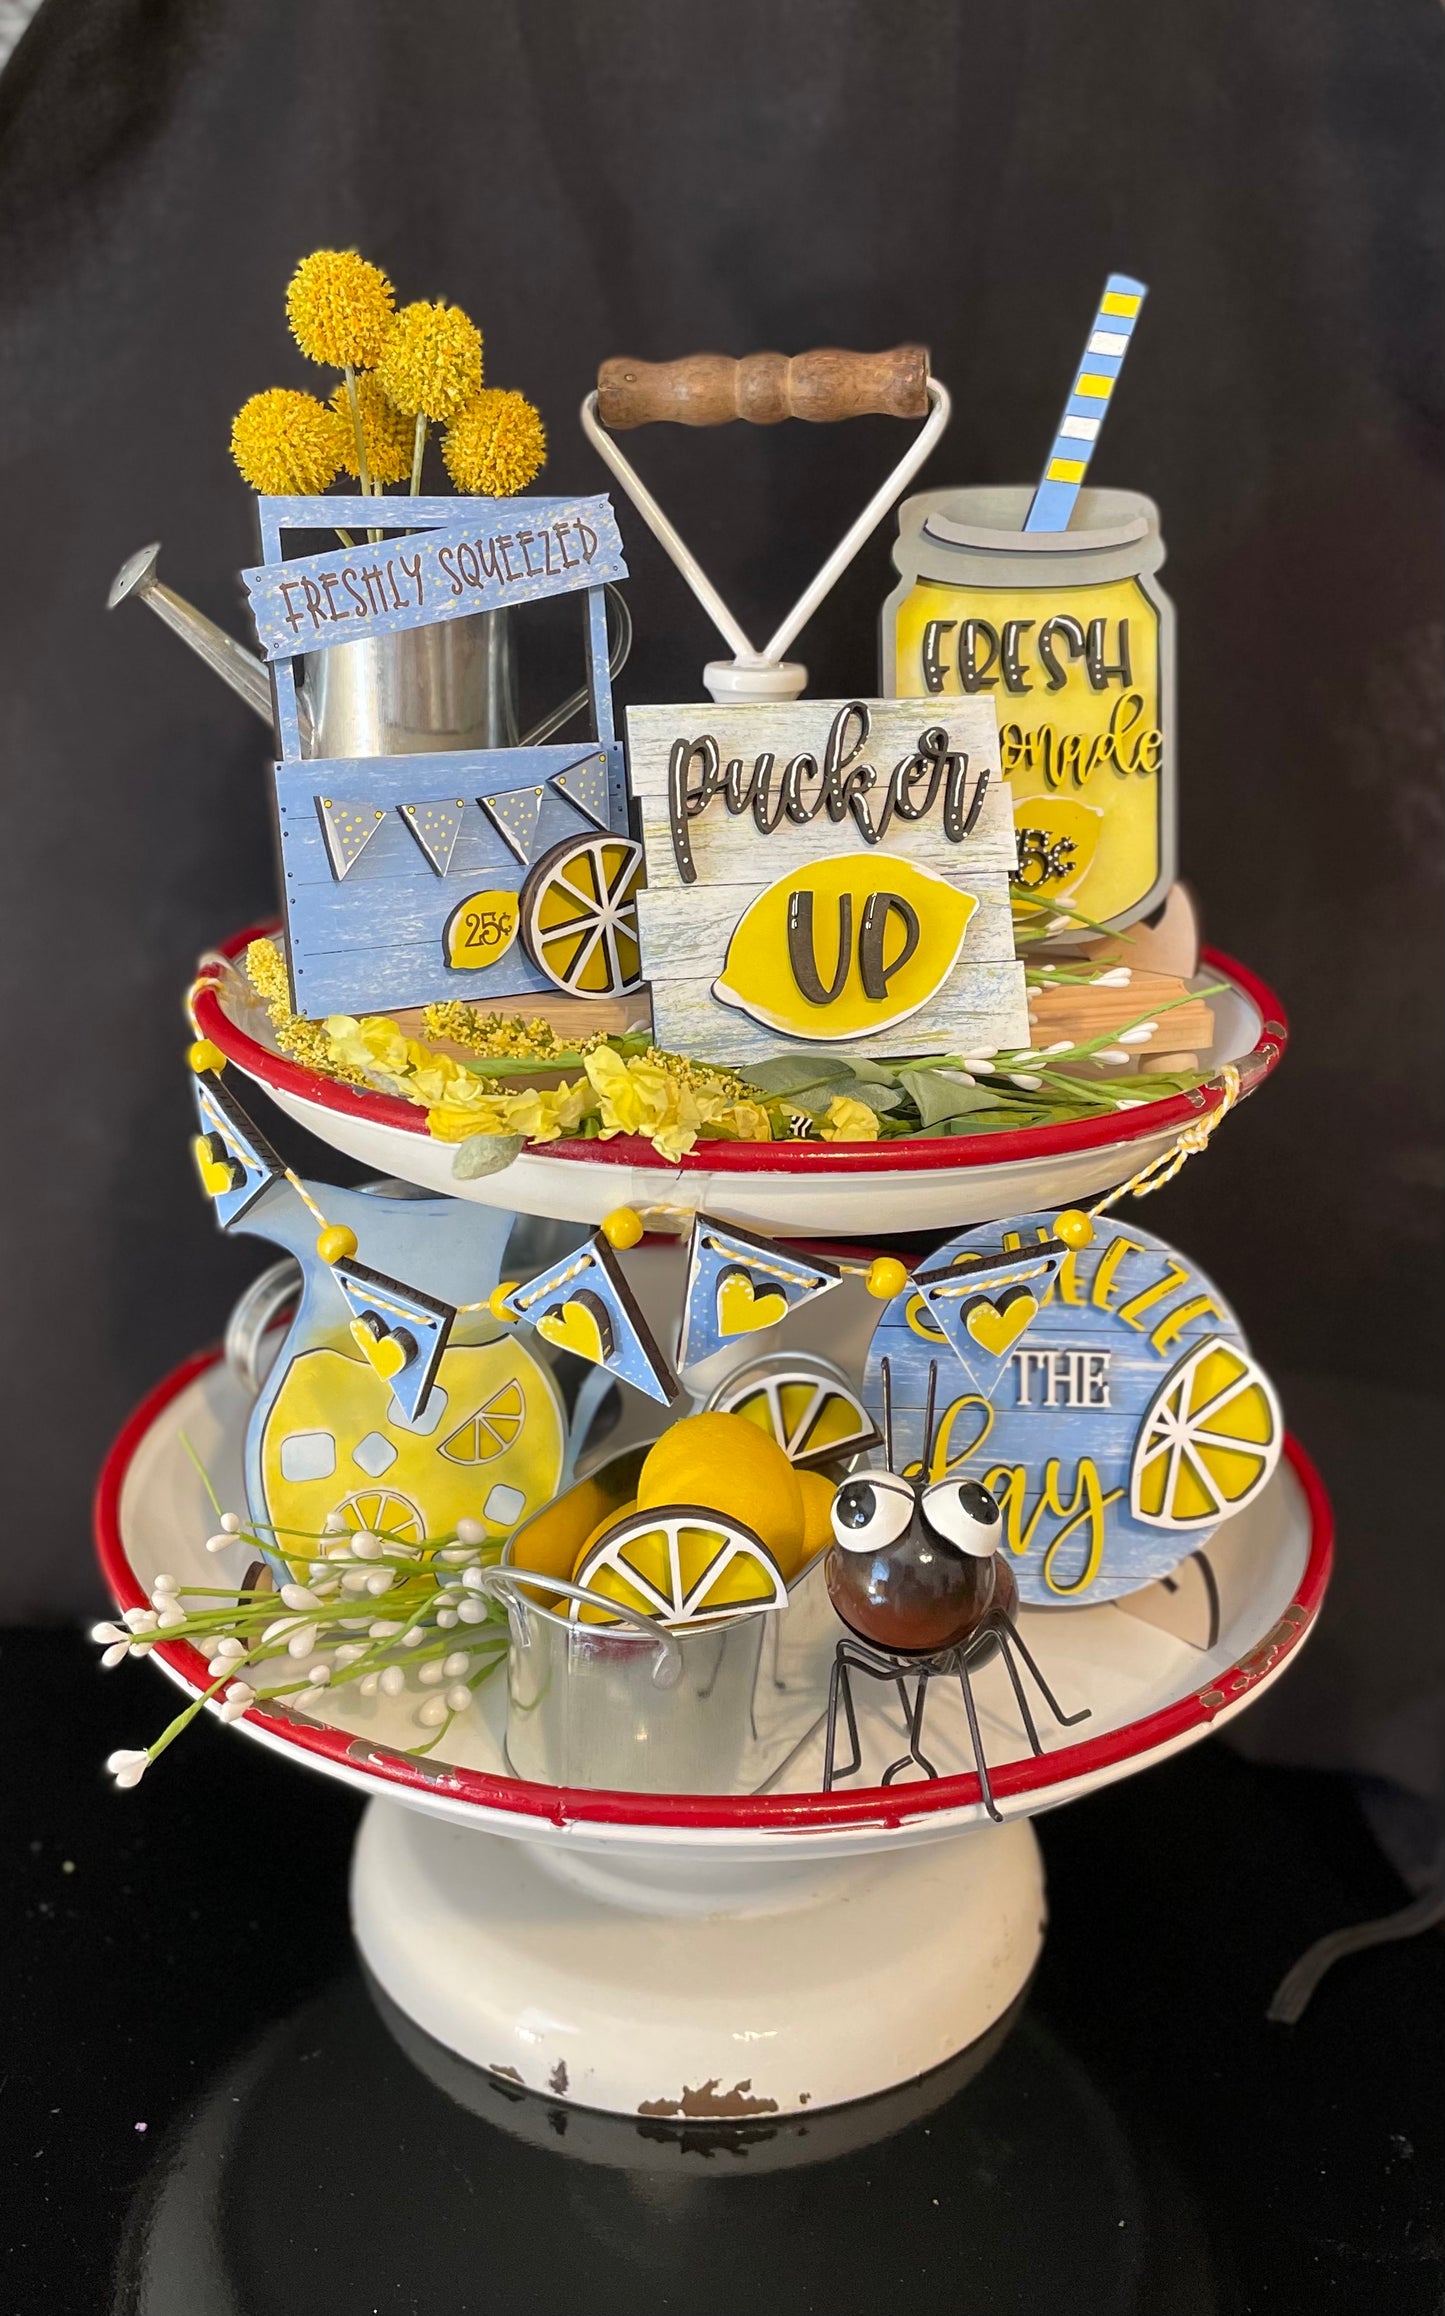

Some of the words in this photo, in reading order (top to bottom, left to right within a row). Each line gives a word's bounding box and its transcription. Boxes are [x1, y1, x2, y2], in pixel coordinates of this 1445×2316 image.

[279, 553, 423, 633] FRESHLY
[438, 517, 598, 596] SQUEEZED
[922, 614, 1134, 692] FRESH
[999, 692, 1163, 786] onade
[668, 700, 991, 884] pucker
[1007, 827, 1078, 888] 5¢
[464, 911, 513, 948] 25¢
[787, 890, 921, 1005] UP
[1006, 1347, 1112, 1409] THE
